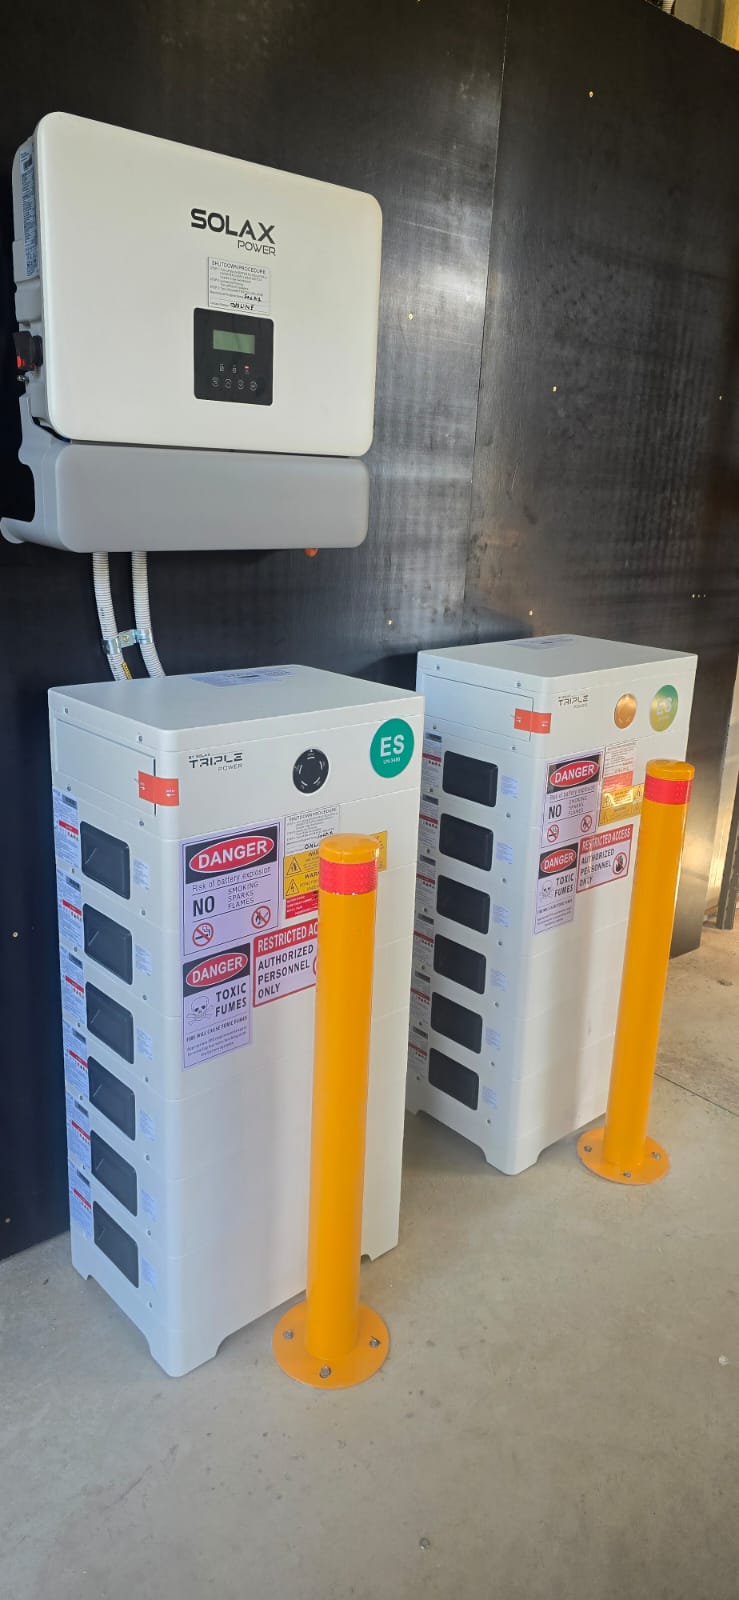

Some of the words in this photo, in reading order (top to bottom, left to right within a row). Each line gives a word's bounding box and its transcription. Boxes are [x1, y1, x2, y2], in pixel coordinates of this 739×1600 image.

[191, 208, 275, 244] SOLAX
[238, 240, 276, 256] POWER
[558, 694, 588, 706] TRIPLE
[380, 734, 405, 757] ES
[188, 752, 243, 769] TRIPLE
[217, 763, 243, 771] POWER
[554, 764, 595, 784] DANGER
[548, 804, 562, 820] NO
[612, 827, 631, 841] ACCESS
[198, 840, 267, 869] DANGER
[544, 852, 574, 870] DANGER
[582, 848, 614, 864] AUTHORIZED
[192, 884, 206, 893] Risk
[209, 881, 215, 889] of
[216, 874, 241, 886] battery
[556, 873, 574, 885] TOXIC
[228, 881, 259, 895] SMOKING
[228, 890, 254, 903] SPARKS
[554, 884, 574, 898] FUMES
[193, 895, 215, 917] NO
[228, 898, 254, 909] FLAMES
[257, 926, 307, 953] RESTRICTED
[257, 944, 314, 971] AUTHORIZED
[192, 956, 243, 984] DANGER
[257, 959, 310, 985] PERSONNEL
[216, 982, 246, 1002] TOXIC
[257, 983, 281, 999] ONLY
[215, 997, 247, 1017] FUMES
